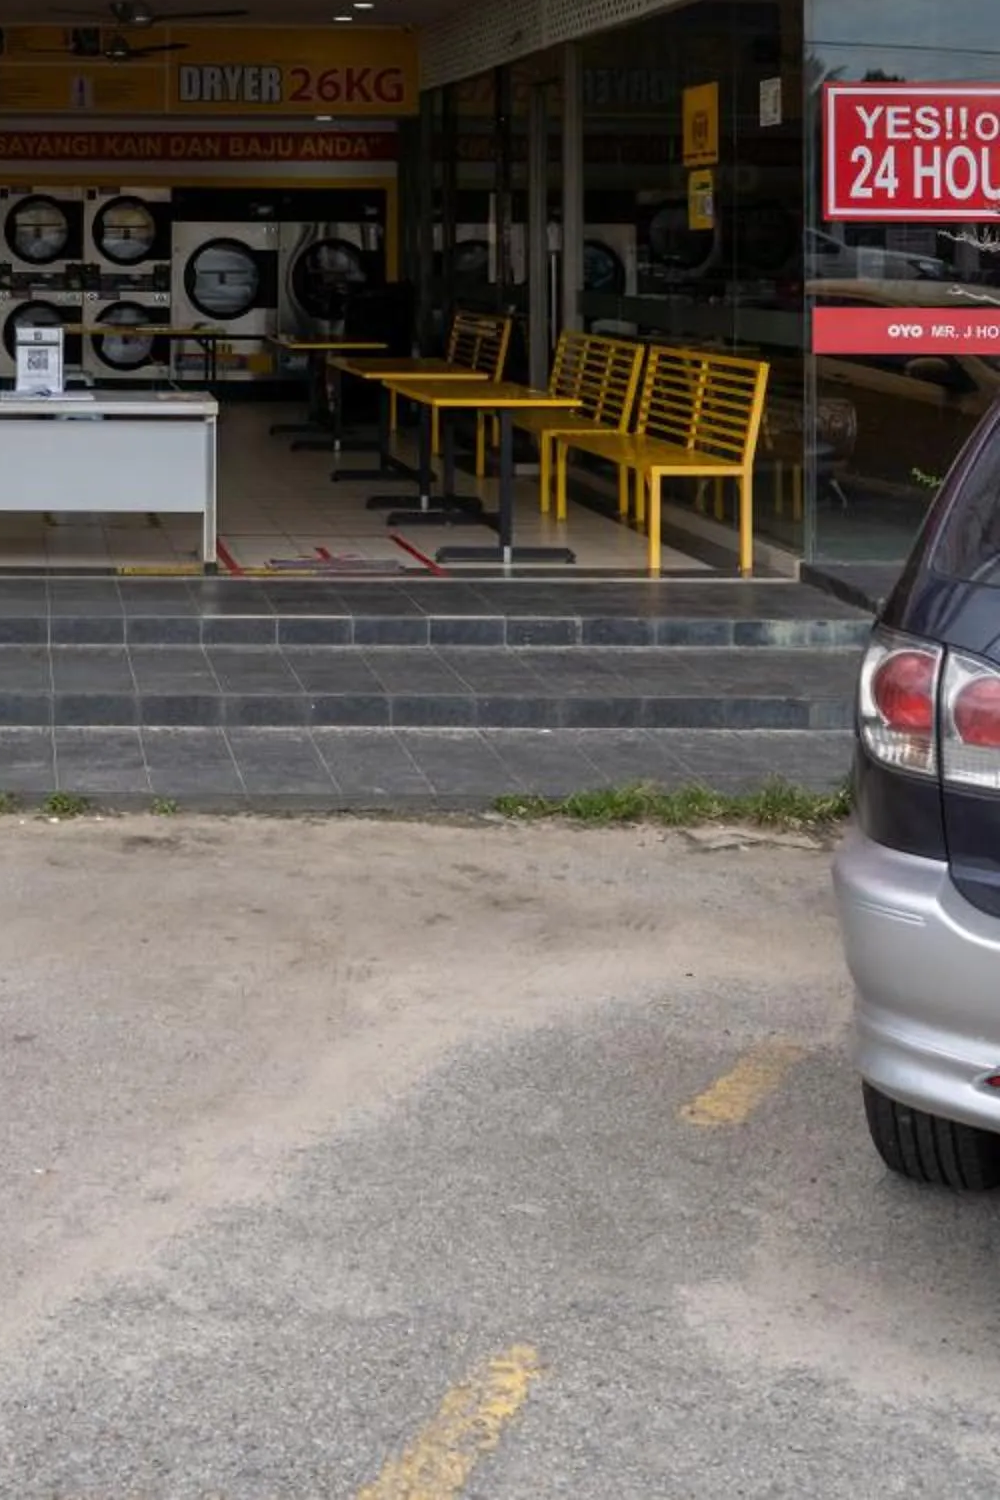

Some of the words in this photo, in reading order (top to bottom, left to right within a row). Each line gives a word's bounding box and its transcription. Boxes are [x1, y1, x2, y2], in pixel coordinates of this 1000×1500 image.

[178, 64, 283, 103] DRYER
[289, 67, 405, 103] 26KG
[103, 137, 162, 157] KAIN
[169, 137, 221, 157] DAN
[229, 137, 293, 157] BAJU
[849, 145, 899, 199] 24
[887, 323, 923, 338] OYO
[976, 324, 1000, 339] HO
